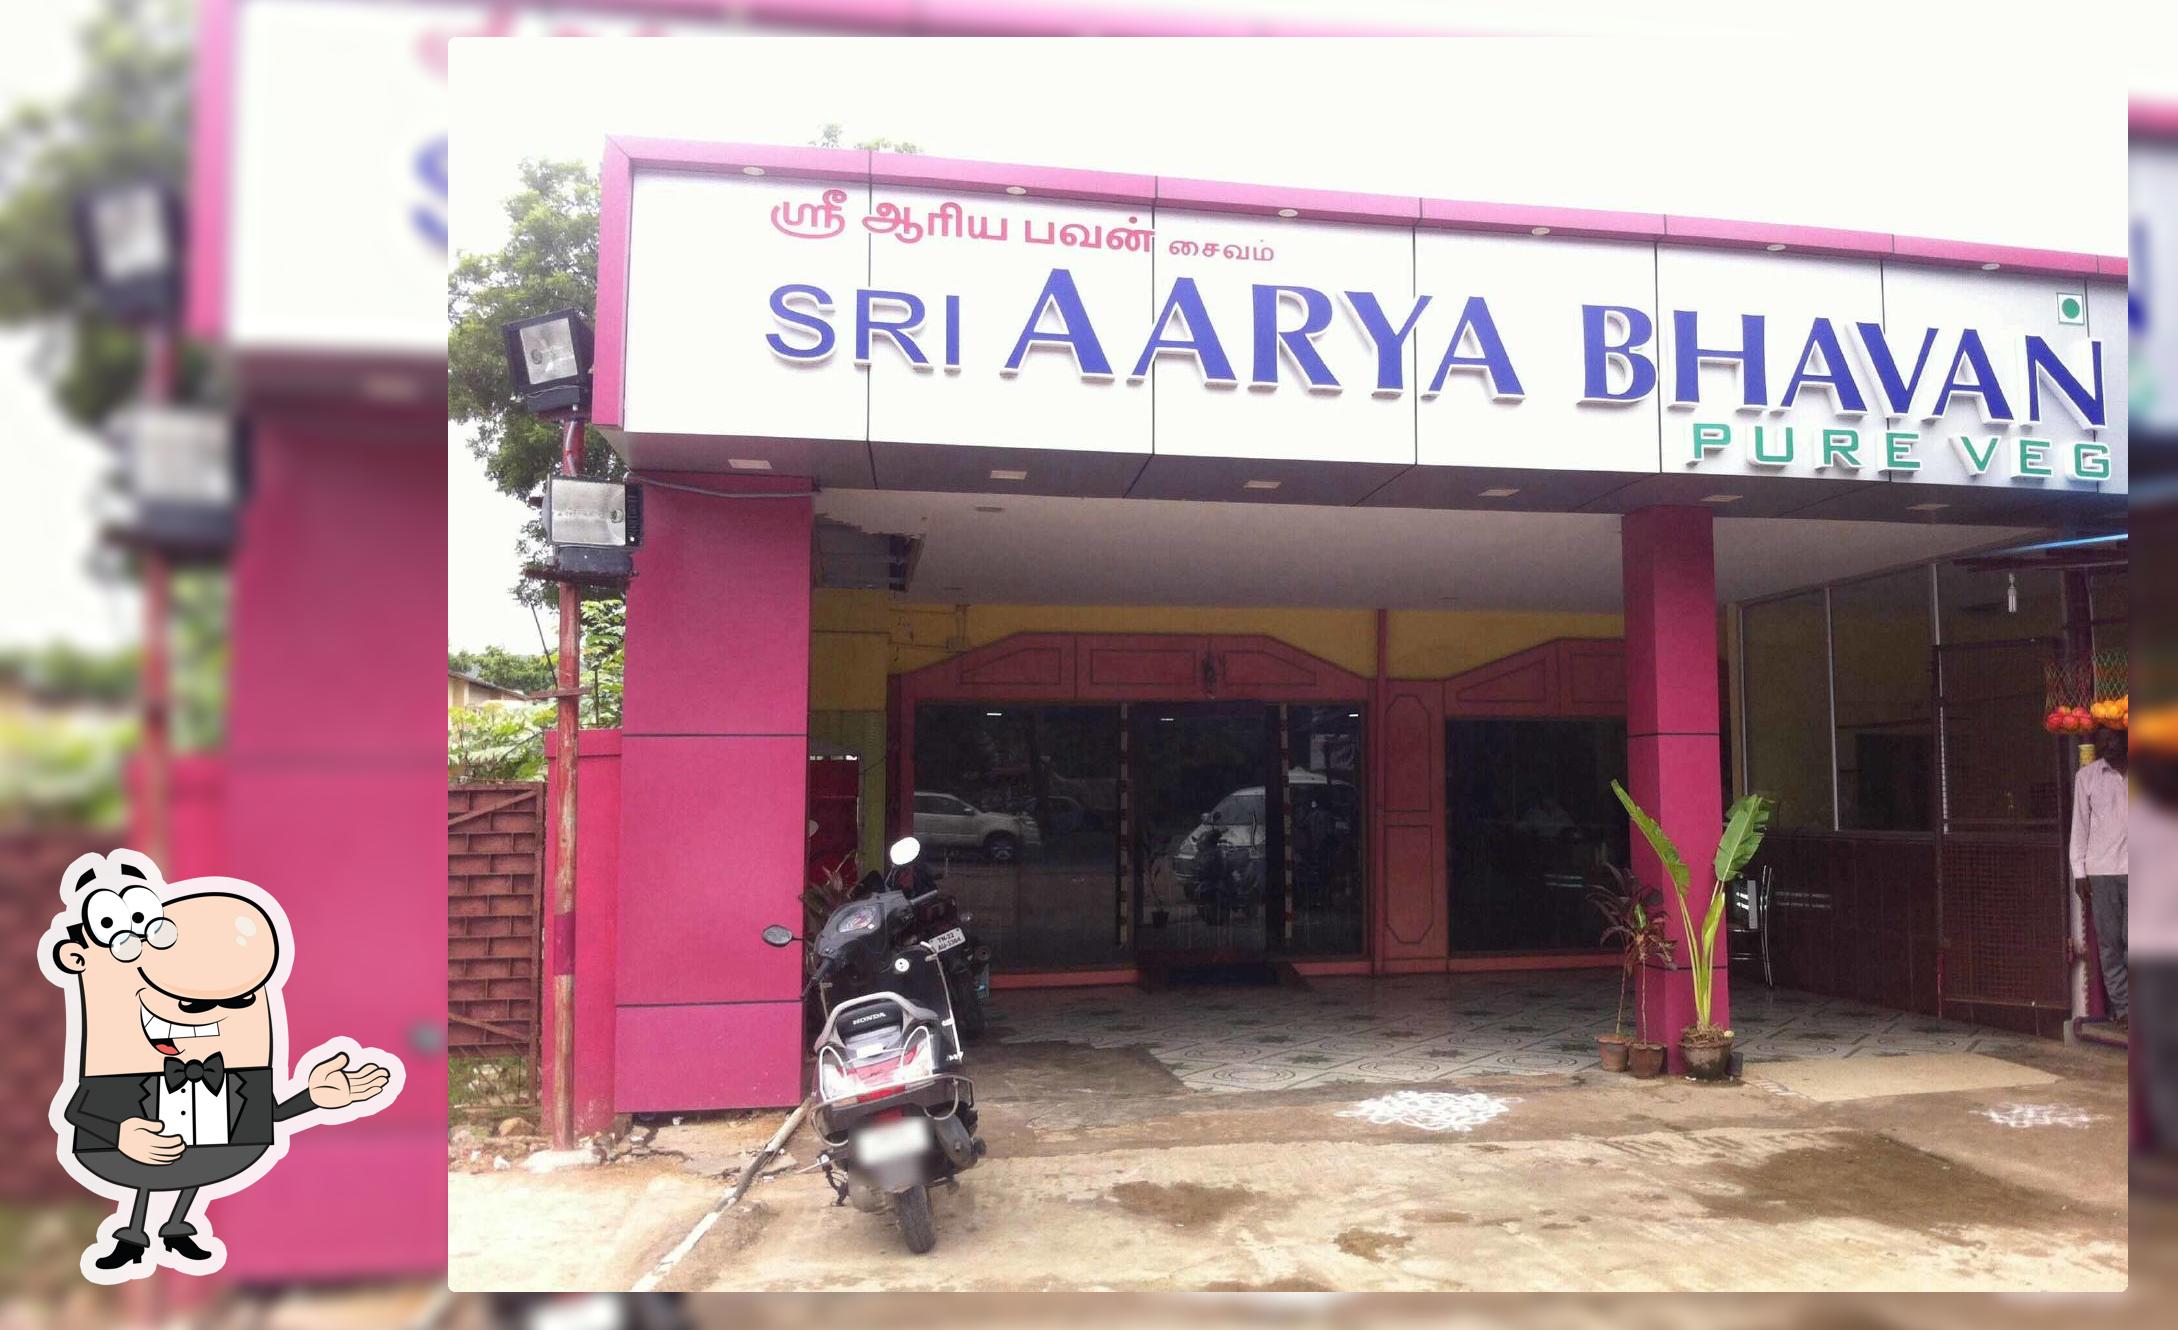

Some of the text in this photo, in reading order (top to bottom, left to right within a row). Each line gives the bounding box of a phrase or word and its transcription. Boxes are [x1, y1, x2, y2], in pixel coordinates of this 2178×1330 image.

[861, 201, 1008, 244] ஆரிய
[1024, 216, 1156, 253] பவன்
[1168, 239, 1275, 262] சைவம்
[766, 268, 2109, 430] SRI AARYA BHAVAN
[1690, 422, 2113, 481] PURE VEG
[852, 1012, 886, 1025] HONDA
